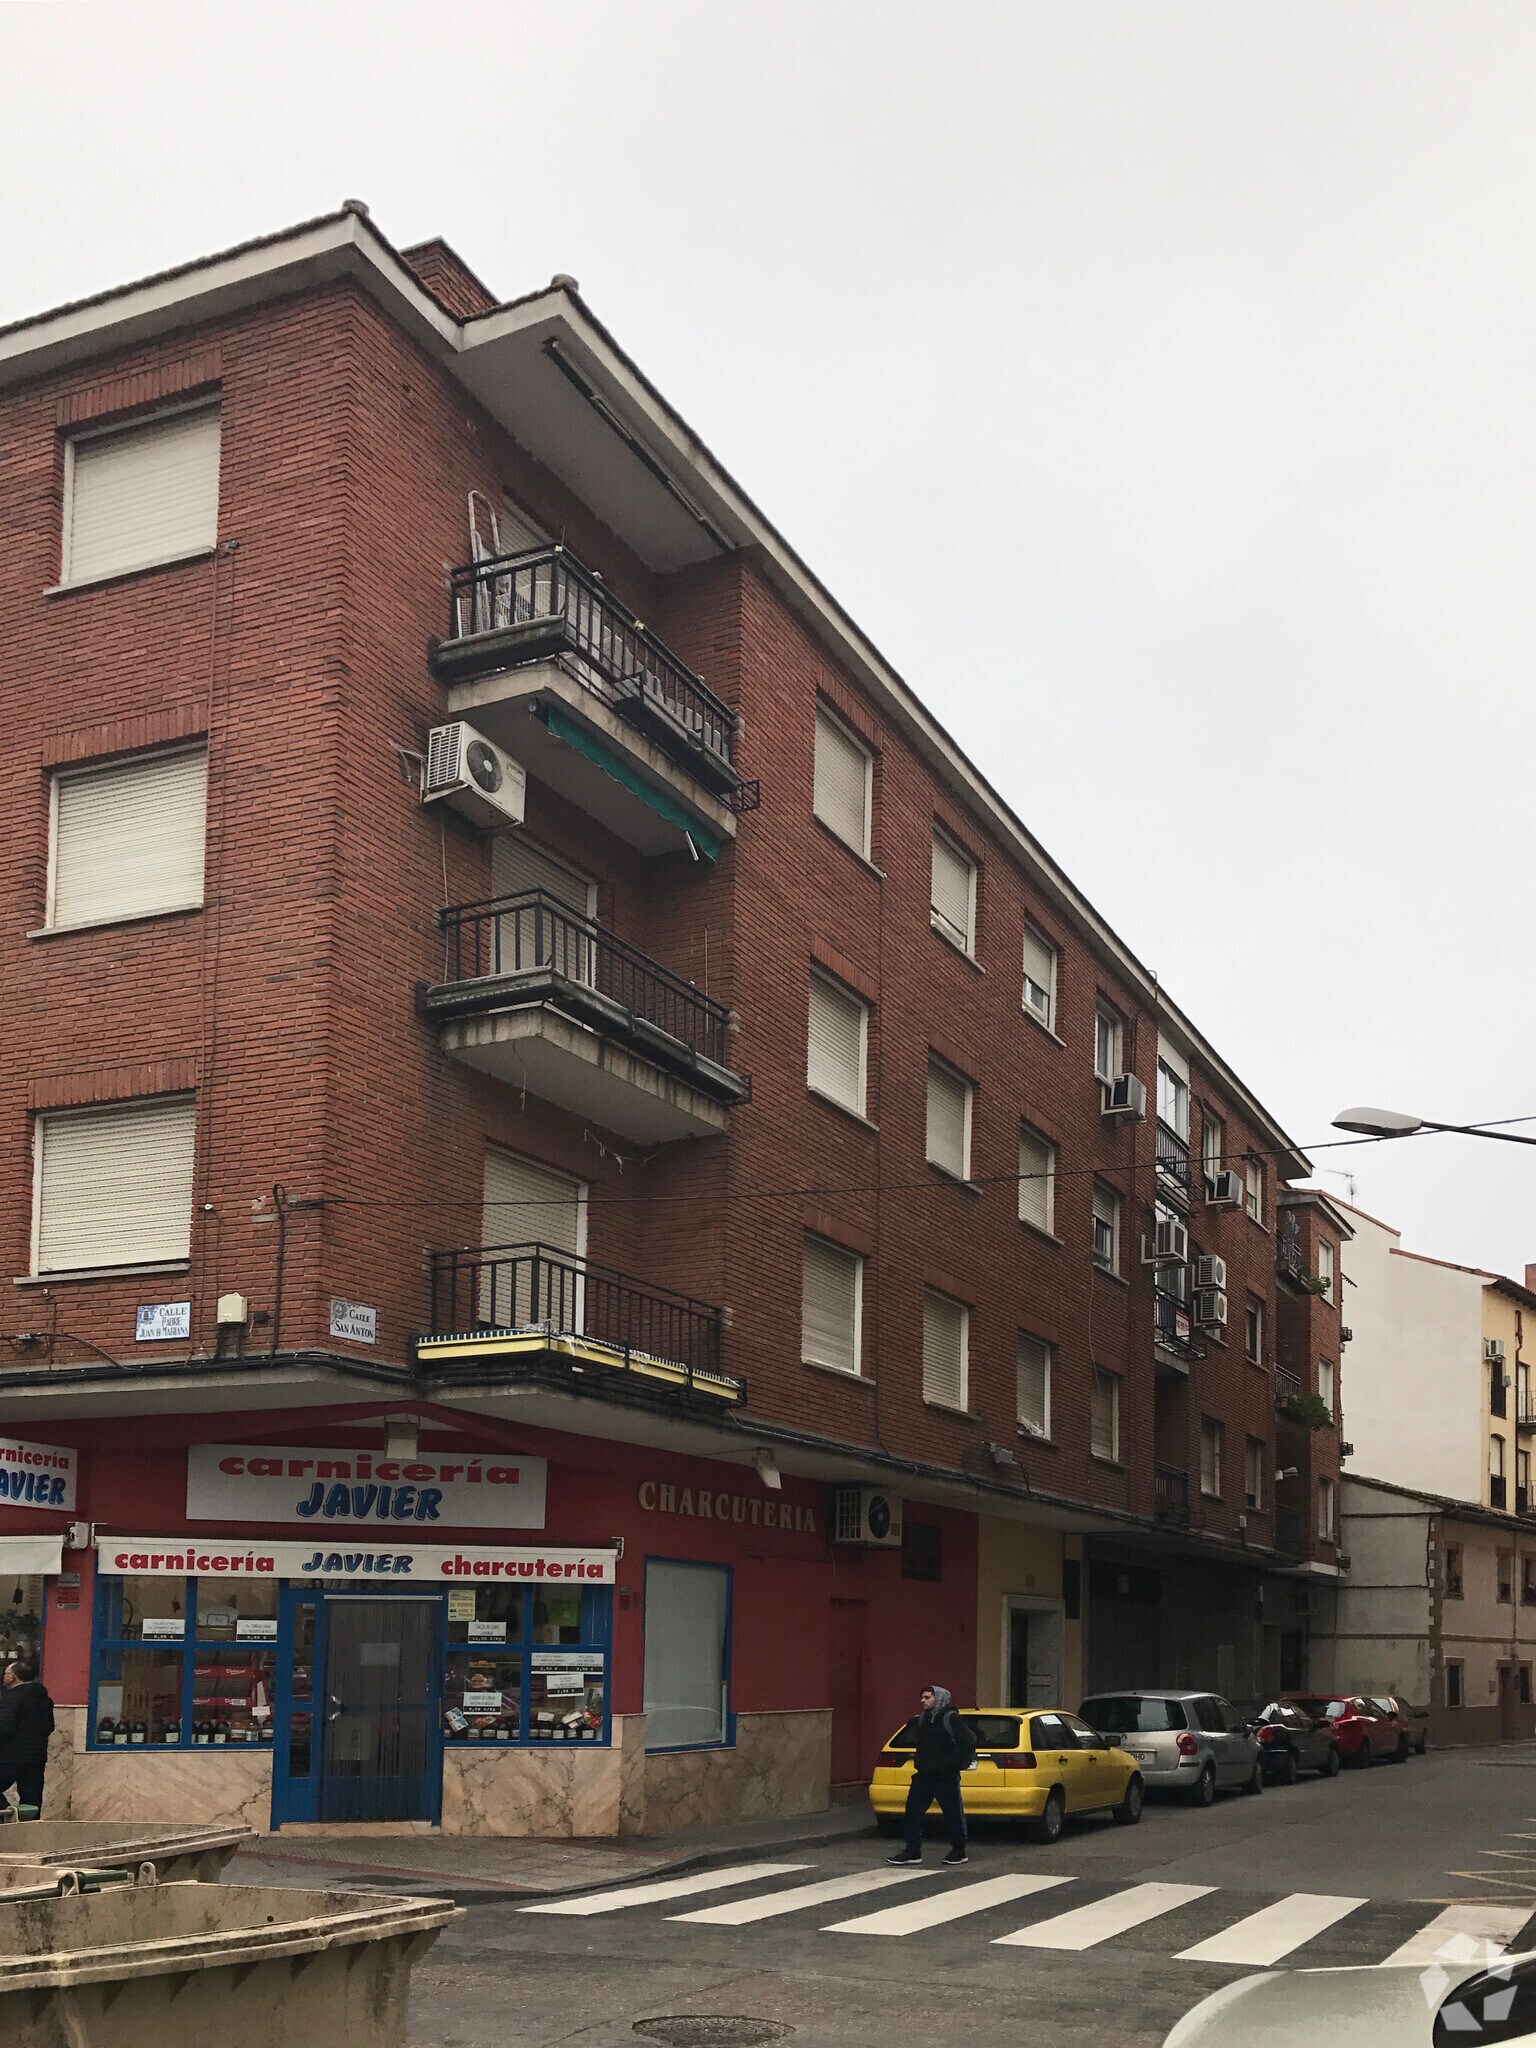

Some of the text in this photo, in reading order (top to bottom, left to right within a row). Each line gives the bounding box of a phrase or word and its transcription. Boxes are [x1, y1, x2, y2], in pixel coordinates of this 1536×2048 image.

[159, 1306, 188, 1317] CALLE
[161, 1316, 182, 1326] PADRE
[349, 1309, 371, 1322] CALLE
[139, 1328, 155, 1338] JUAN
[162, 1326, 189, 1336] MARIANA
[334, 1320, 374, 1339] SAN ANTON
[218, 1453, 520, 1484] carnicería
[296, 1481, 444, 1522] JAVIER
[638, 1481, 816, 1532] CHARCUTERIA
[114, 1549, 604, 1579] carnicería JAVIER charcutería
